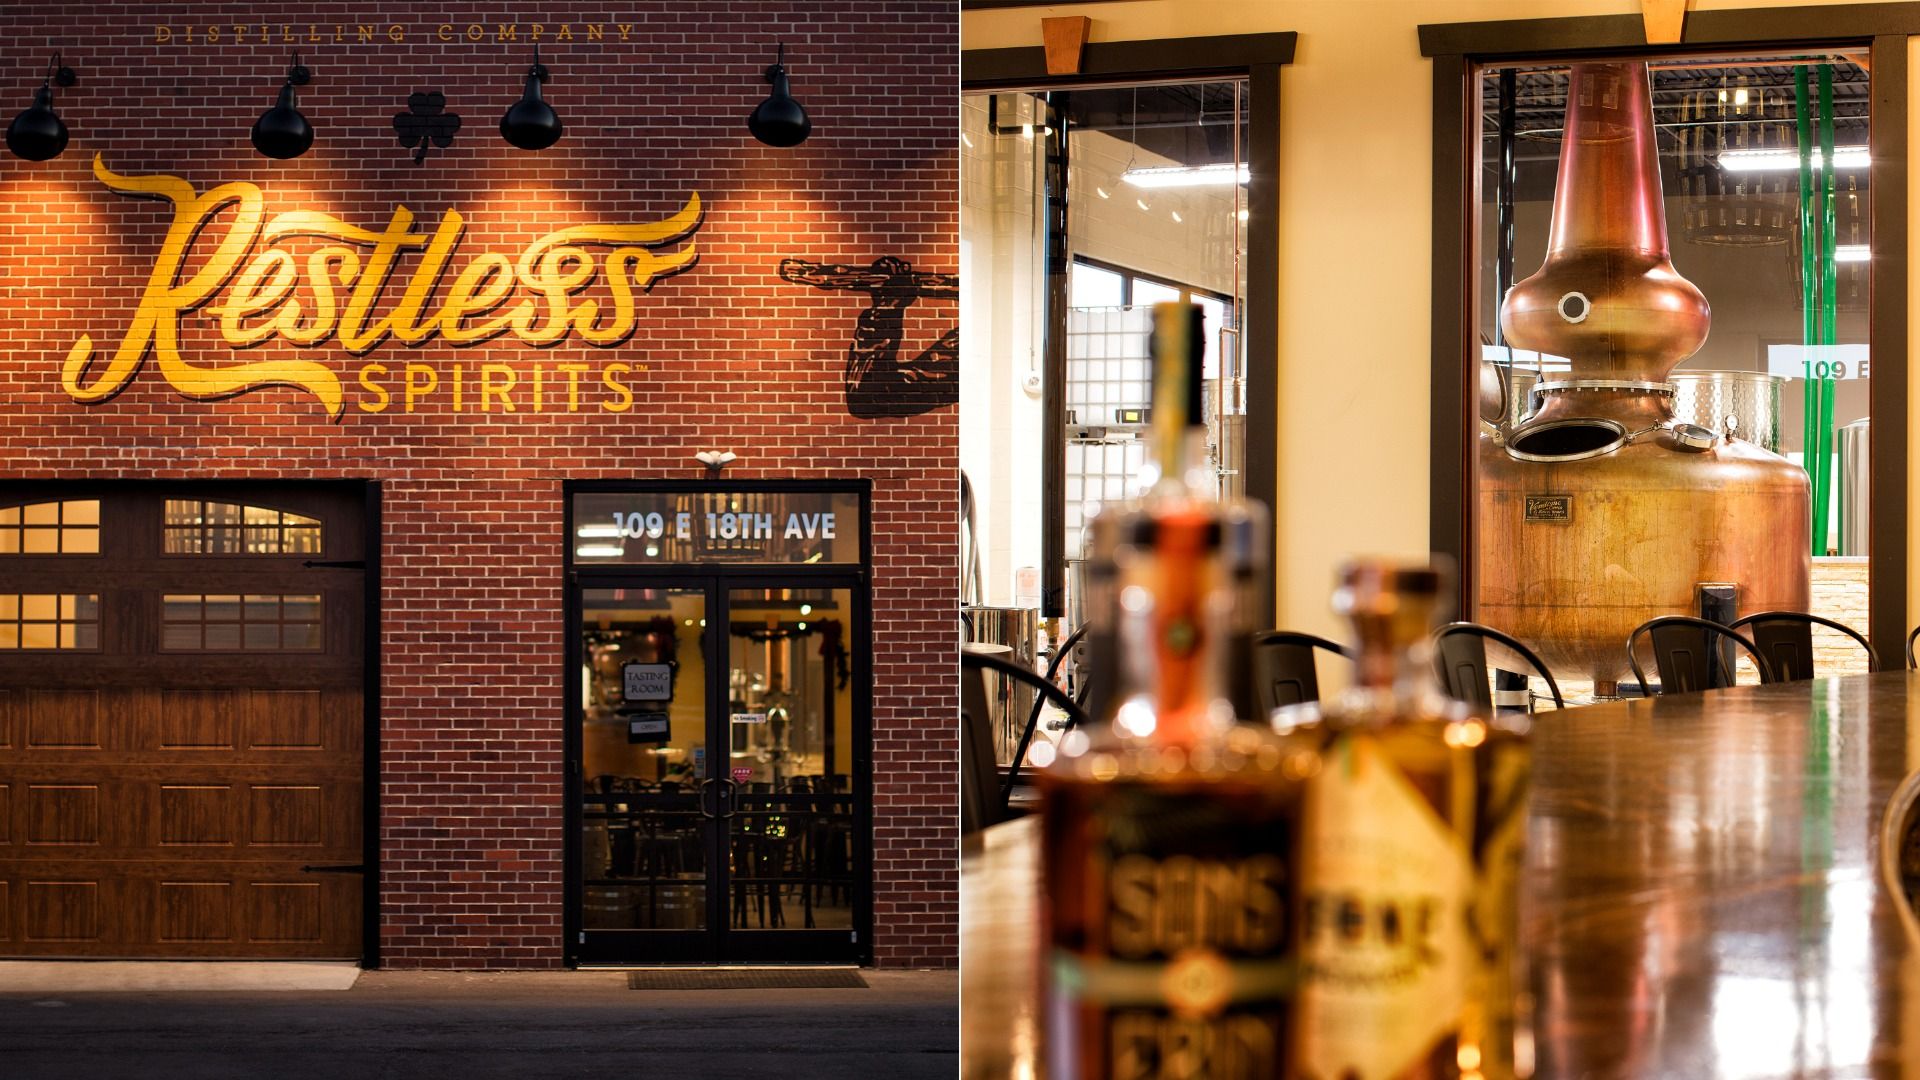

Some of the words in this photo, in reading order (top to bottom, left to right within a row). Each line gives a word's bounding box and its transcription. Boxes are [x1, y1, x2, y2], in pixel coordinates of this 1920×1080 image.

[155, 24, 405, 43] DISTILLING
[438, 23, 634, 42] COMPANY
[61, 150, 702, 420] Restless
[1801, 360, 1847, 379] 109
[1857, 360, 1869, 379] E
[613, 512, 664, 539] 109
[676, 512, 691, 539] E
[706, 512, 772, 540] 18TH
[784, 512, 836, 540] AVE
[627, 672, 669, 681] TASTING
[631, 684, 664, 694] ROOM
[1111, 853, 1287, 958] SONS
